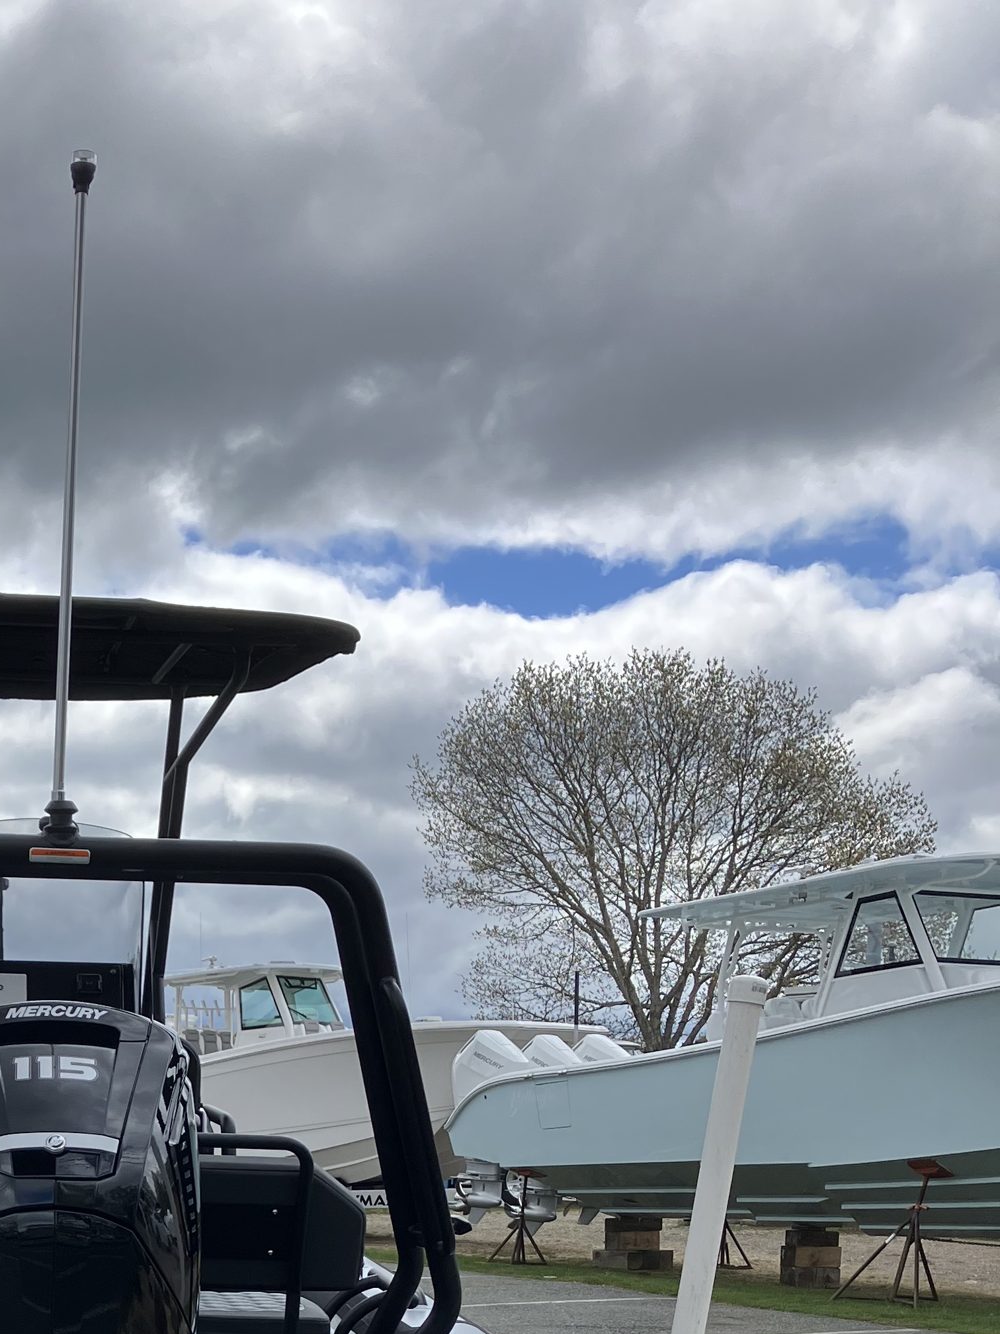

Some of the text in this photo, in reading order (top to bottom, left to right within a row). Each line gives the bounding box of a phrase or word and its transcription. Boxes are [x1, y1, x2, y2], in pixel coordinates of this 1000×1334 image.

[5, 1005, 108, 1020] MERCURY
[13, 1055, 98, 1081] 115
[473, 1051, 504, 1070] MERCURY
